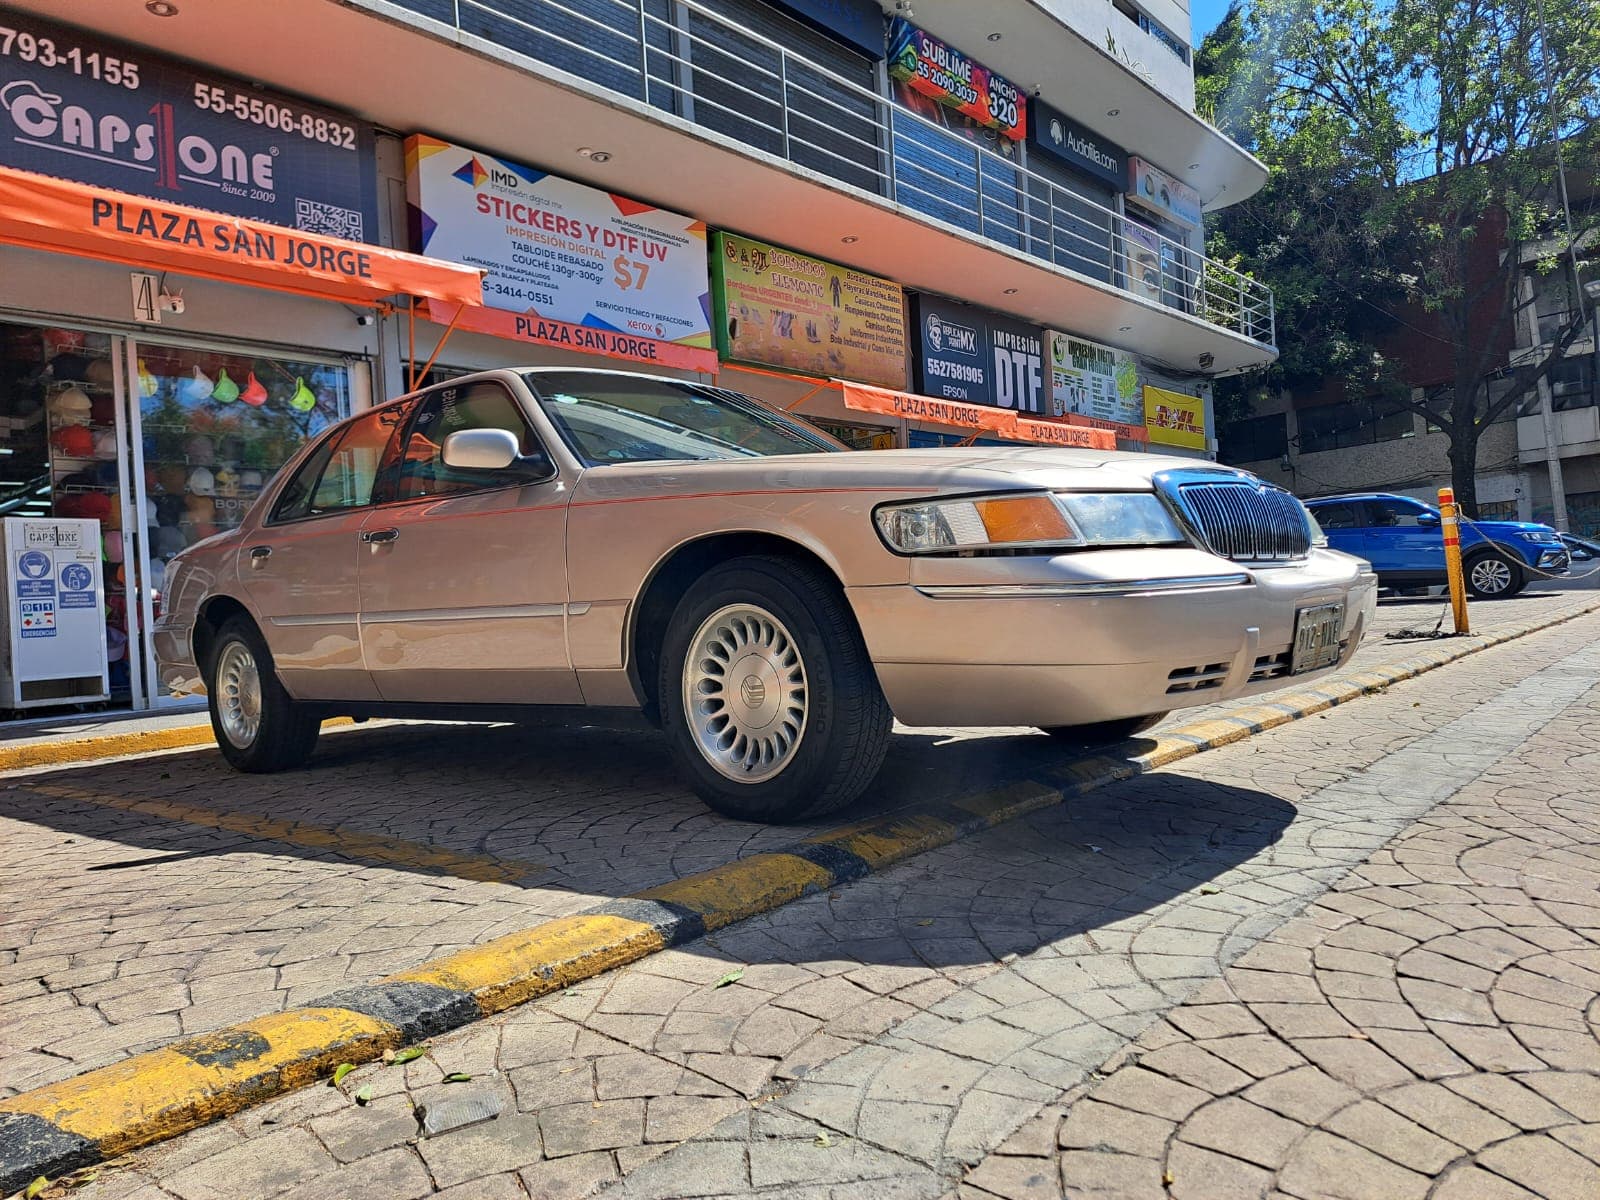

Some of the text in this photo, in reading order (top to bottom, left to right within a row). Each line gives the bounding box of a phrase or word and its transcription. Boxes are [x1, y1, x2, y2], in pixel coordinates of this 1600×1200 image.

[922, 38, 972, 83] SUBLIME
[917, 61, 978, 104] 55 2090 3037
[989, 77, 1017, 102] ANCHO
[194, 82, 357, 150] 55-5506-8832
[989, 92, 1017, 127] 320
[221, 182, 276, 204] Since 2009
[491, 169, 518, 188] IMD
[92, 197, 206, 248] PLAZA
[214, 224, 276, 261] SAN
[283, 239, 372, 279] JORGE
[475, 192, 668, 262] STICKERS Y DTF UV
[505, 224, 607, 260] IMPRESIÓN DIGITAL
[511, 241, 604, 272] TABLOIDE REBASADO
[512, 254, 605, 285] COUCHÉ 130gr-300gr
[613, 254, 650, 291] $7
[482, 281, 554, 306] 5-3414-0551
[595, 300, 624, 313] SERVICIO
[515, 316, 657, 359] PLAZA SAN JORGE
[627, 319, 653, 332] xerox
[960, 329, 976, 353] MX
[993, 329, 1041, 356] IMPRESIÓN
[927, 357, 984, 385] 5527581905
[994, 346, 1042, 413] DTF
[943, 384, 968, 399] EPSON
[893, 395, 979, 424] PLAZA SAN JORGE
[1031, 425, 1090, 444] PLAZA SAN JORGE
